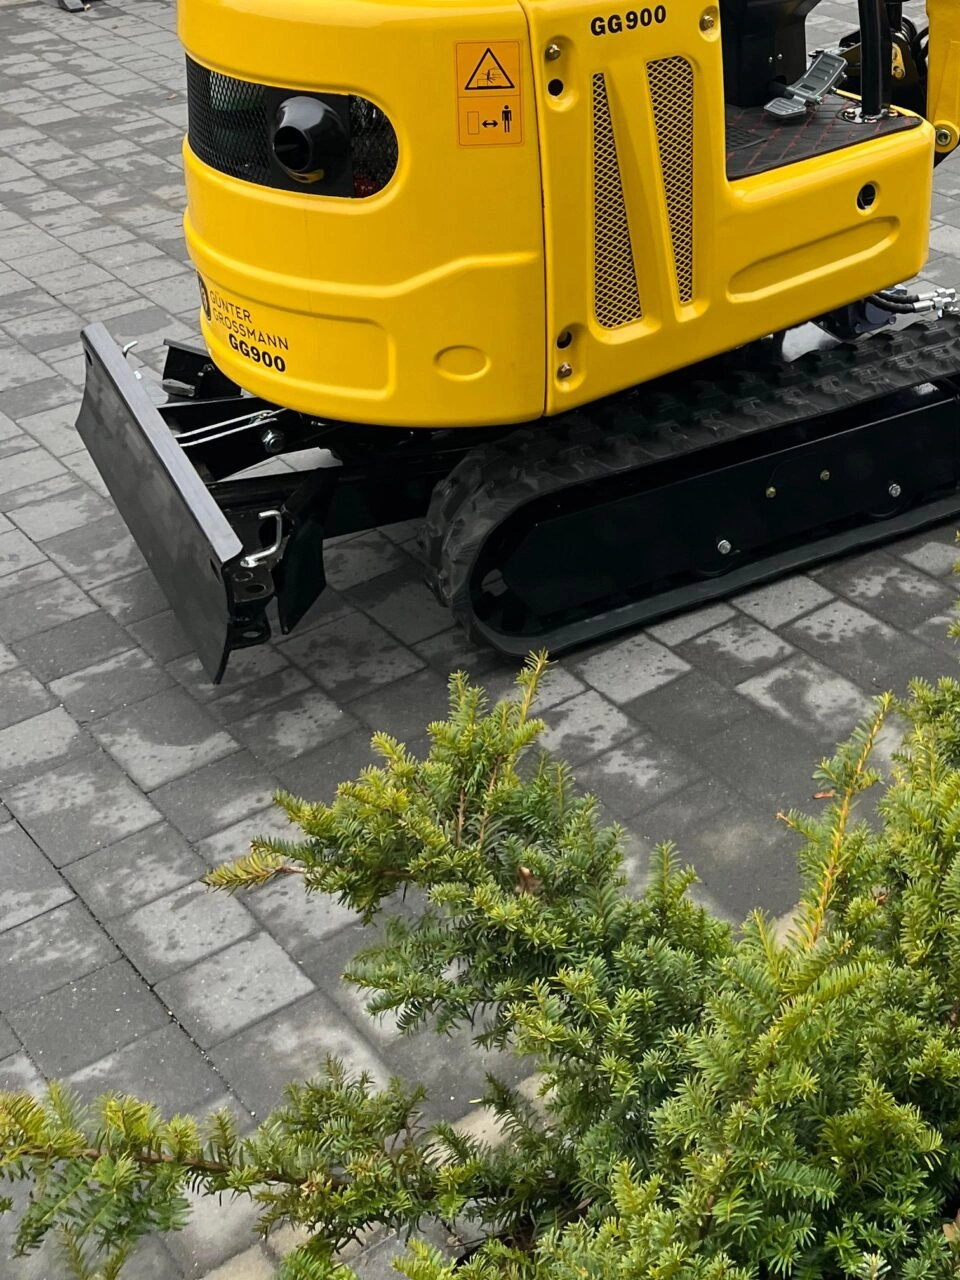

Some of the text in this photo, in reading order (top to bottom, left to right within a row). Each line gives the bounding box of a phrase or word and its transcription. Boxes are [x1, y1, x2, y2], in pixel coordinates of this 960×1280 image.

[590, 4, 667, 37] GG900
[209, 289, 252, 324] GÜNTER
[212, 308, 289, 351] GROSSMANN
[228, 333, 286, 373] GG900
